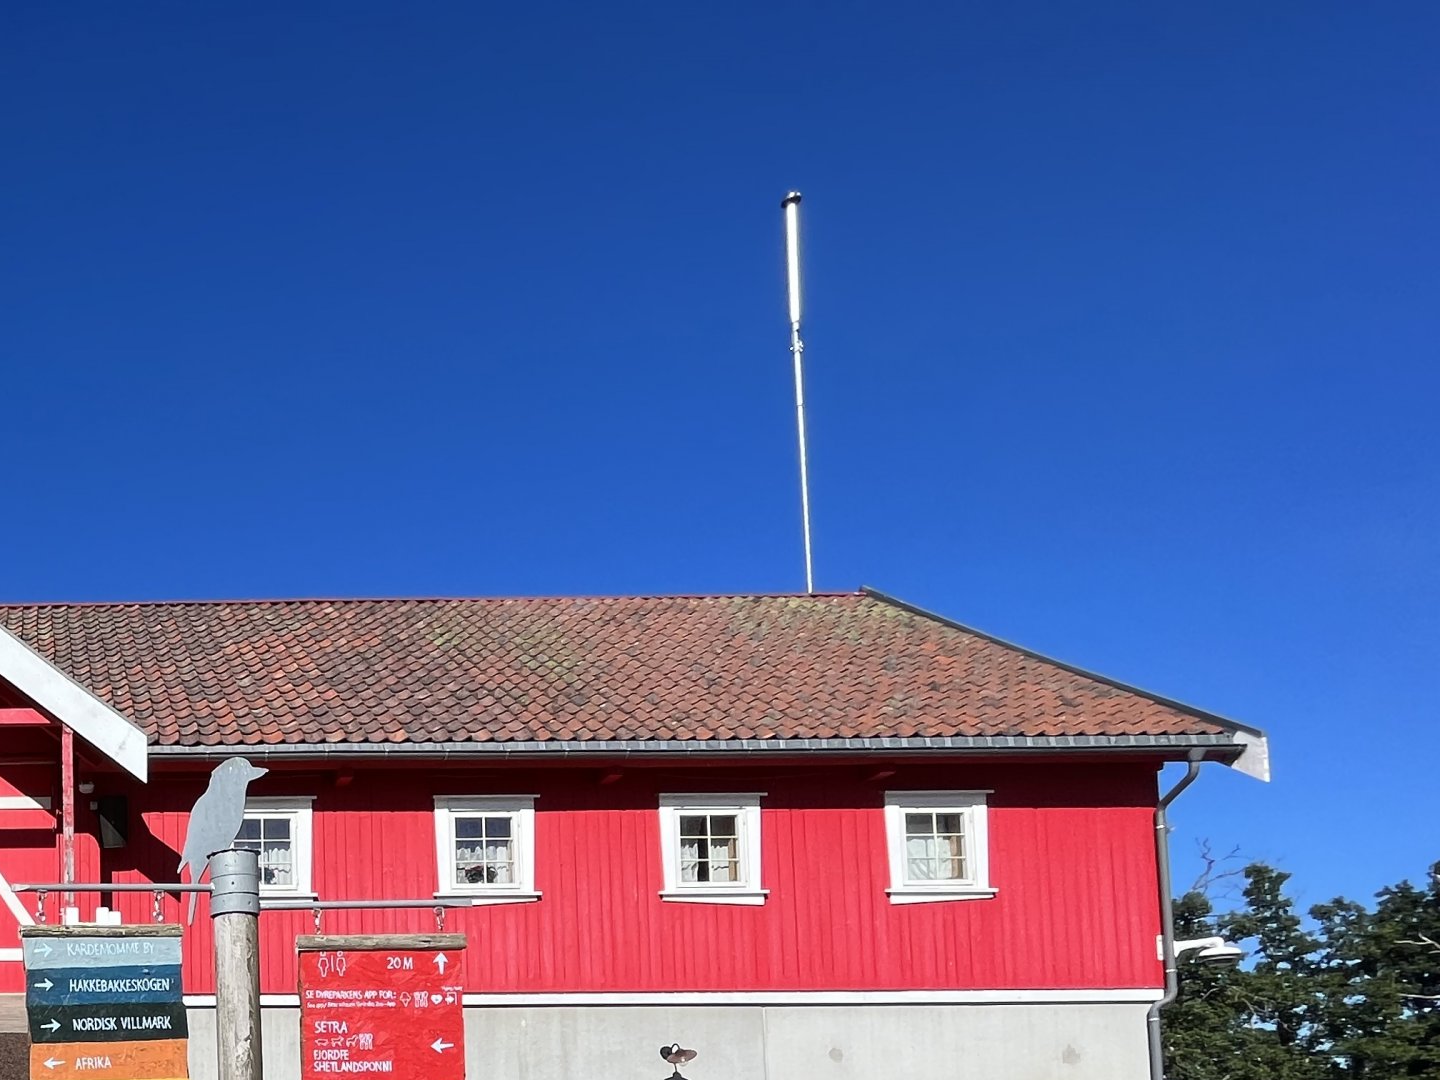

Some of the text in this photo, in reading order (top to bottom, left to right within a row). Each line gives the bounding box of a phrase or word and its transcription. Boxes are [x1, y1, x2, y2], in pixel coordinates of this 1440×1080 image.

[66, 942, 155, 956] KARDEMOMME BY
[386, 957, 414, 970] 20 M
[69, 978, 170, 993] HAKKEBAKKESKOGEN
[72, 1016, 172, 1031] NORDISK VILLMARK
[314, 1020, 348, 1034] SETRA
[75, 1056, 112, 1070] AFRIKA
[313, 1060, 393, 1073] SHETLANDSPONNI
